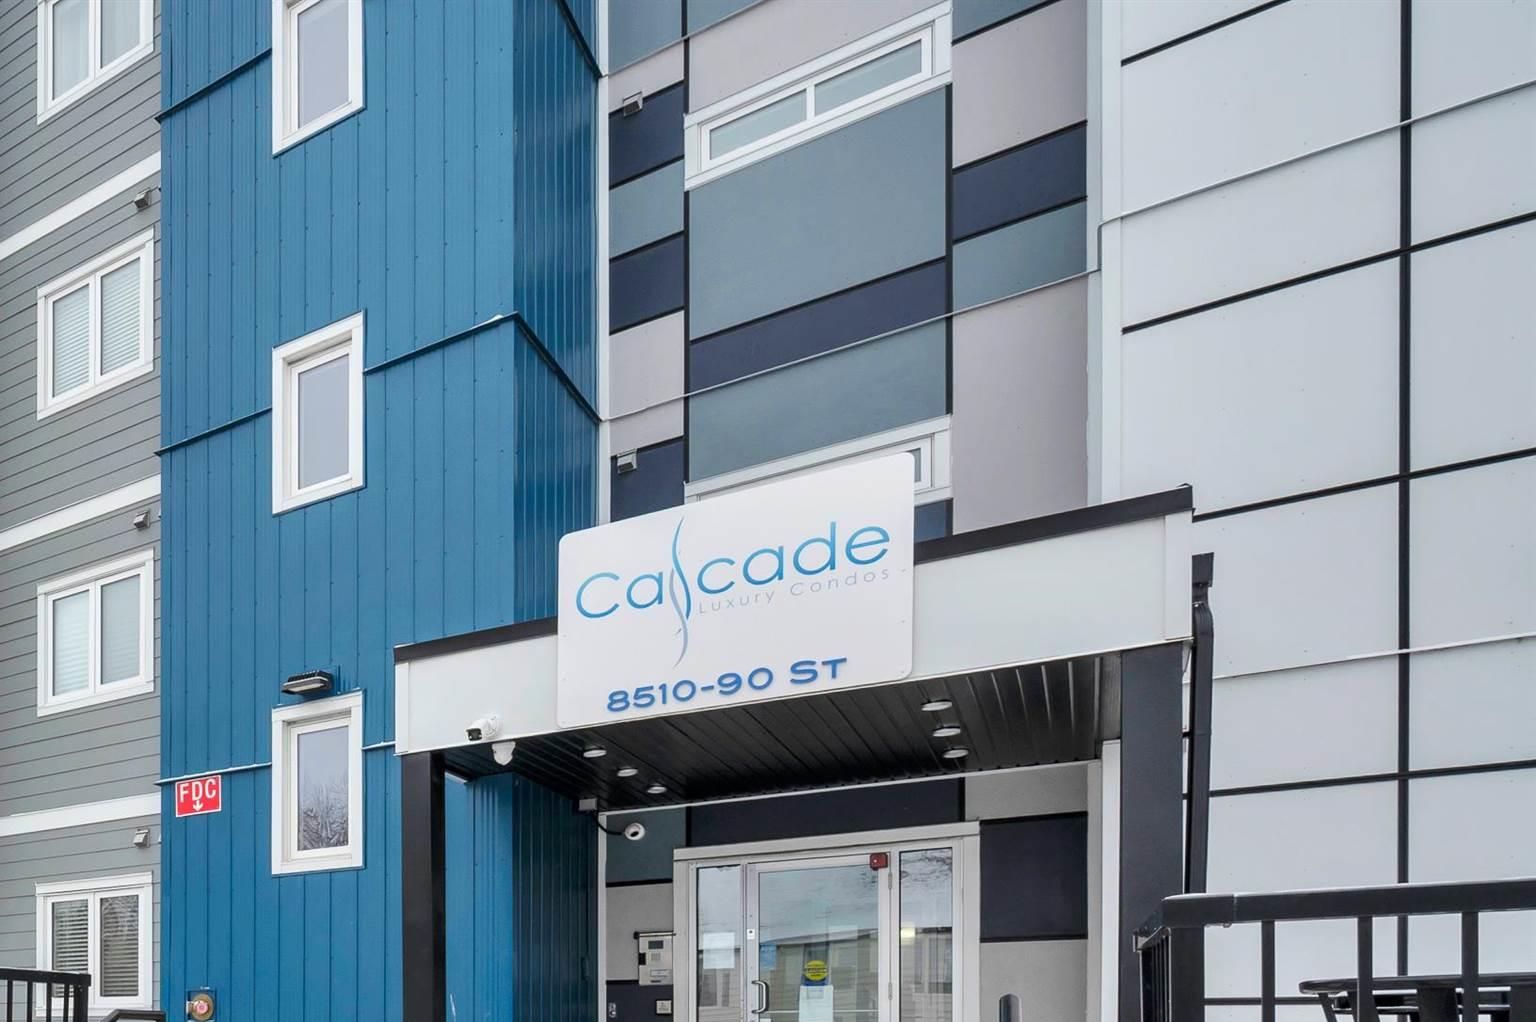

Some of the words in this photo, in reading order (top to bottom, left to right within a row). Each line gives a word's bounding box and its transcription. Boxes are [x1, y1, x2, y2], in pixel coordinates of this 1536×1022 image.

[699, 590, 775, 614] Luxury
[790, 568, 889, 596] Condos
[606, 667, 774, 712] 8510-90
[789, 658, 847, 684] ST
[179, 779, 216, 803] FDC
